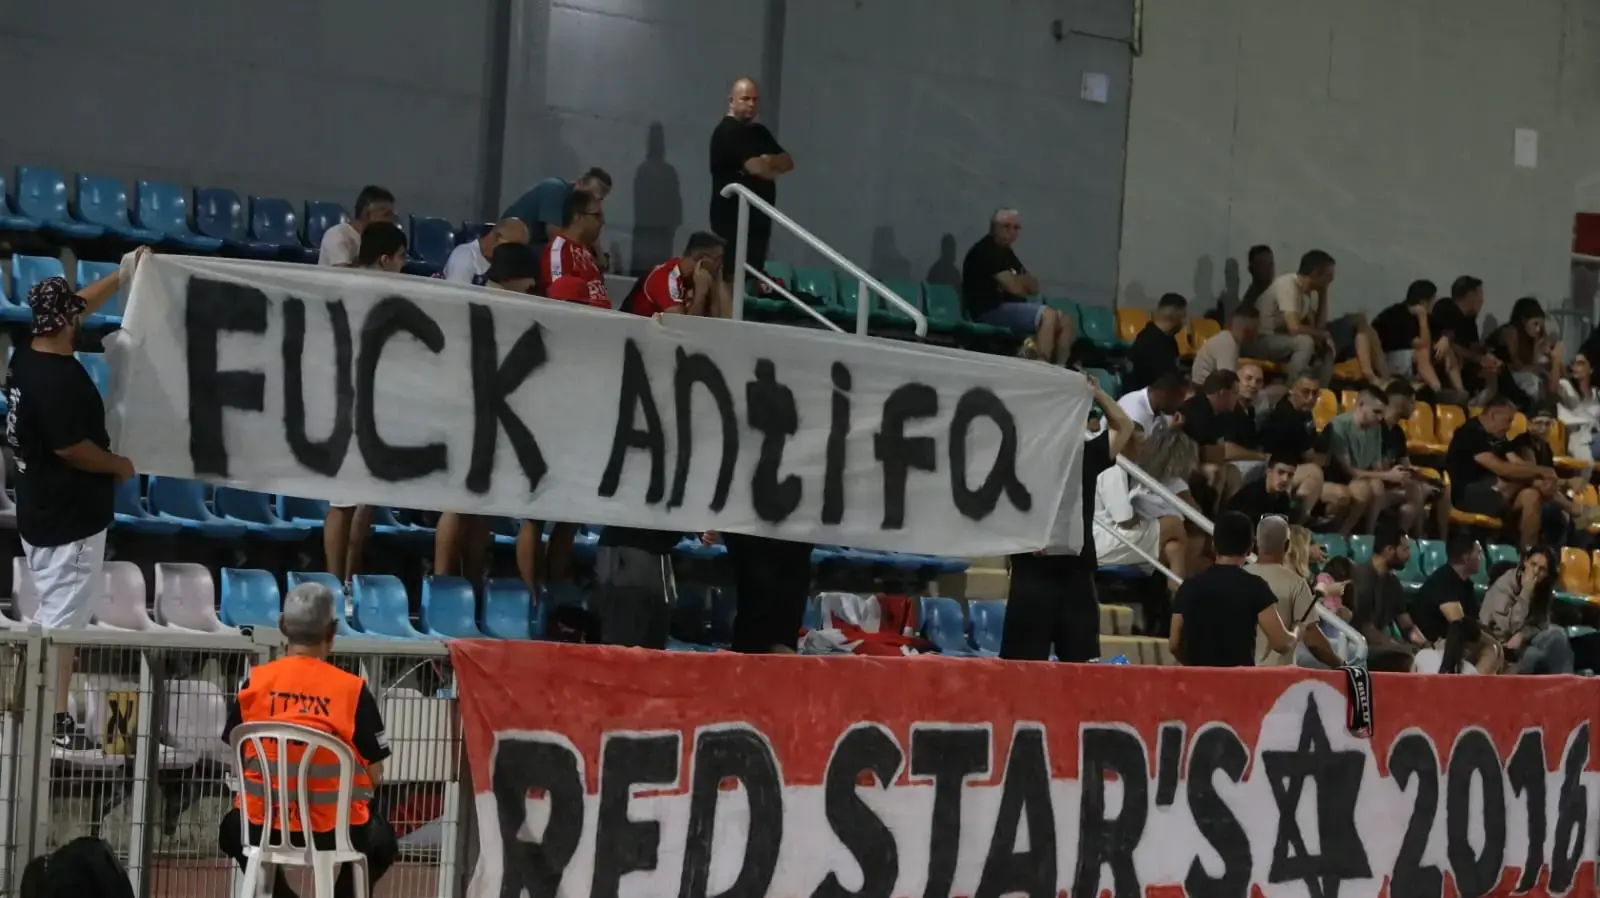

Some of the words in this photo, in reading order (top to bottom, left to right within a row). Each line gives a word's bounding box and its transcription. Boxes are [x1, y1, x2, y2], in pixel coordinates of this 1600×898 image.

[186, 275, 549, 494] FUCK
[597, 337, 1032, 530] Antifa
[491, 724, 783, 898] RED
[806, 721, 1252, 898] STAR'S
[1388, 722, 1590, 896] 2016
